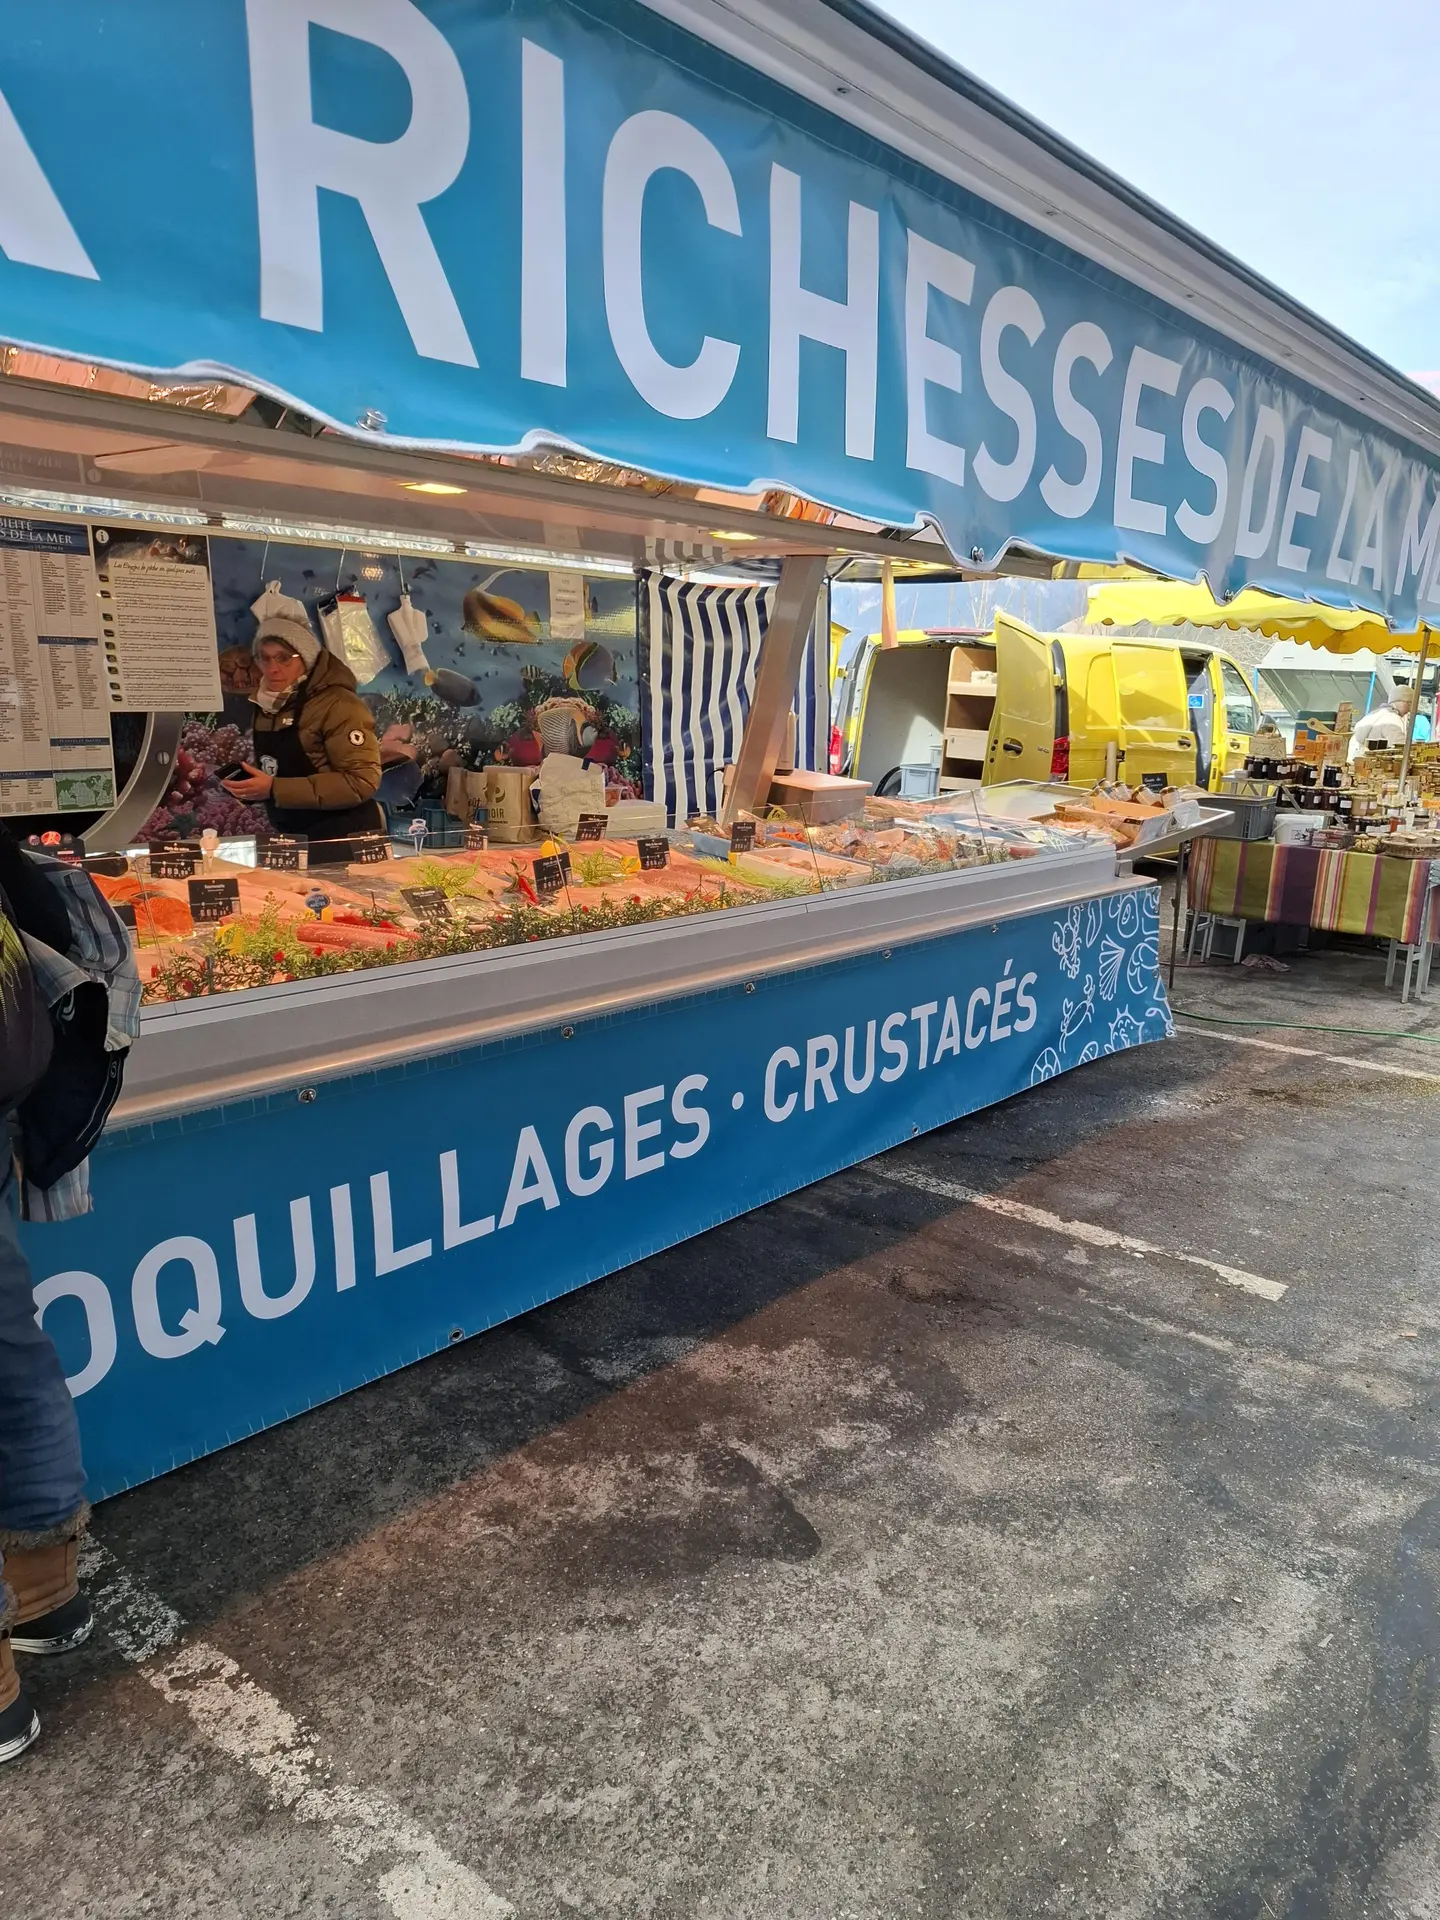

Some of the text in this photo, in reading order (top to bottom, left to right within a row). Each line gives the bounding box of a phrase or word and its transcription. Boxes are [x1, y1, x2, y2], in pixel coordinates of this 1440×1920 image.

[245, 0, 1236, 544] RICHESSES
[1235, 404, 1333, 573] DE
[1326, 449, 1395, 591] LA
[10, 529, 26, 540] DE
[30, 532, 43, 542] LA
[46, 532, 73, 544] MER
[763, 958, 1040, 1124] CRUSTACÉS
